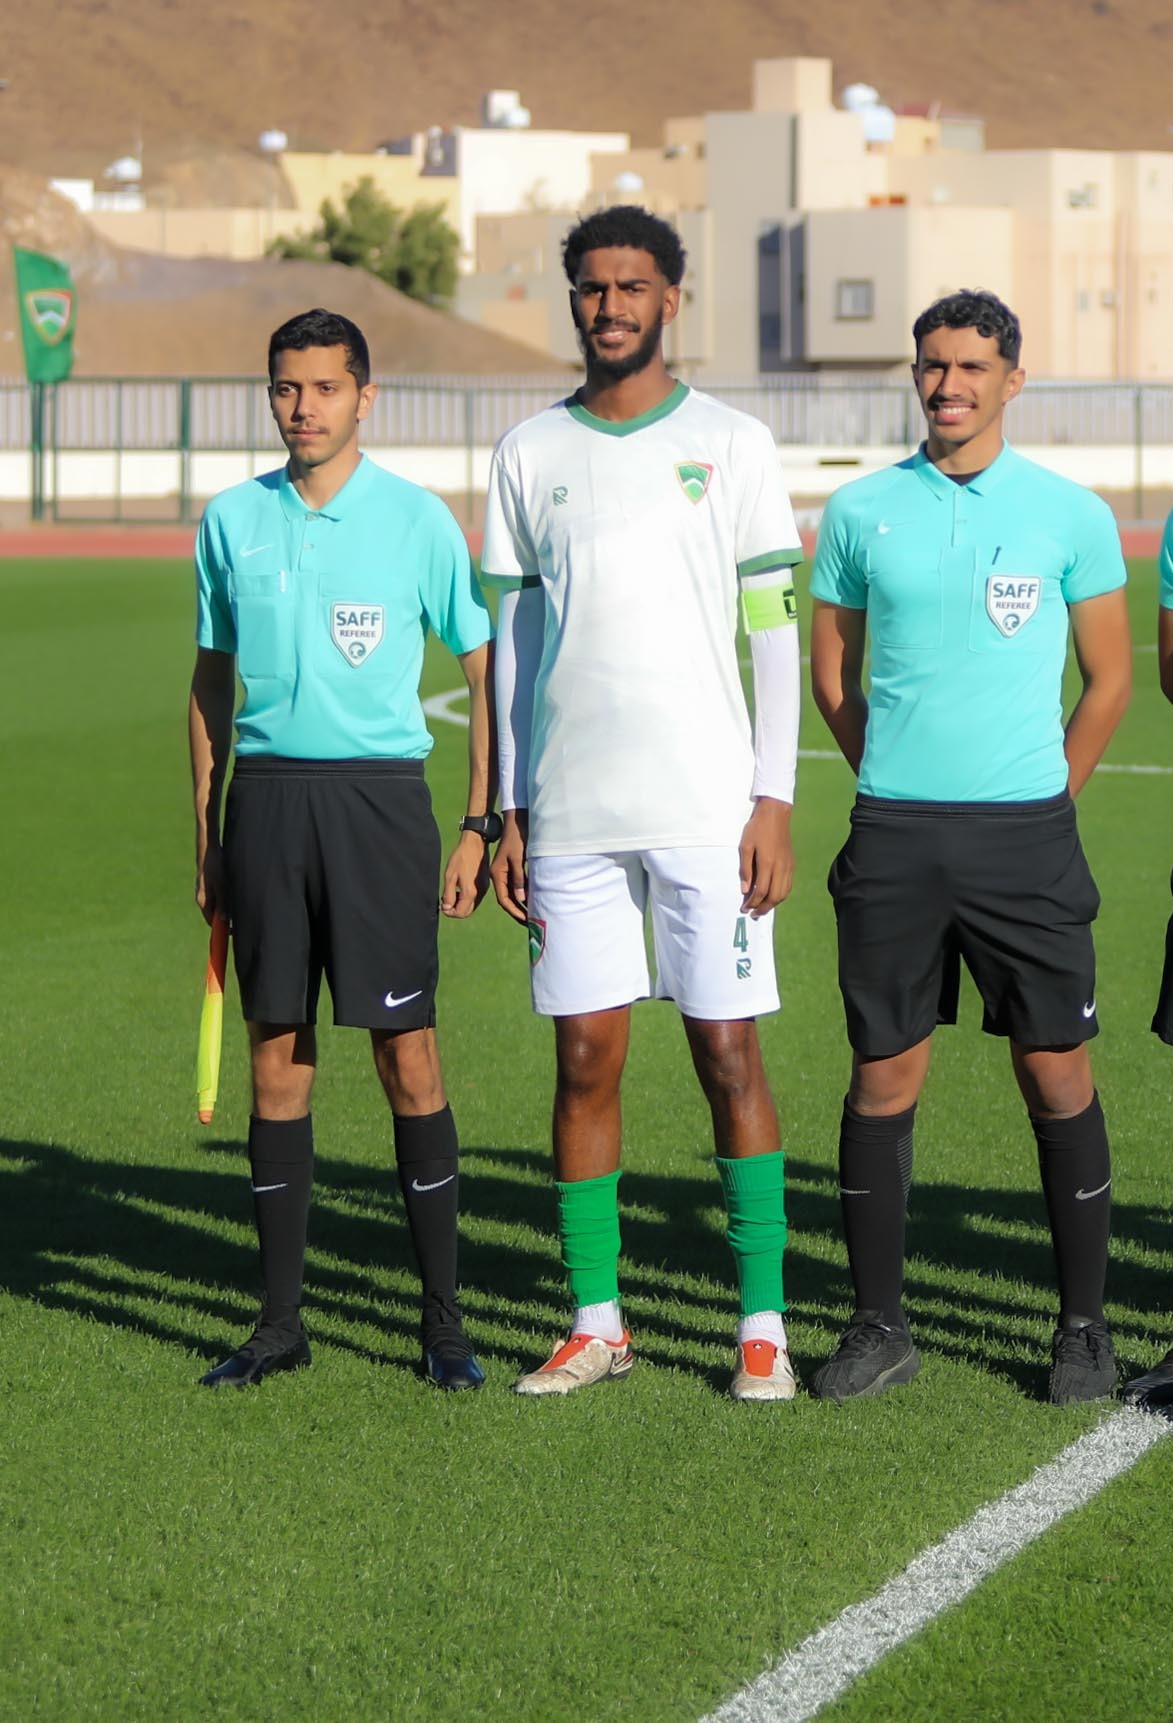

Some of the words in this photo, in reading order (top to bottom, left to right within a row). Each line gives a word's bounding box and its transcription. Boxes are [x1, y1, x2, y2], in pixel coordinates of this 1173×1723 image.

[993, 583, 1038, 598] SAFF
[996, 601, 1032, 609] REFEREE
[336, 611, 381, 626] SAFF
[340, 630, 376, 638] REFEREE
[733, 916, 749, 952] 4
